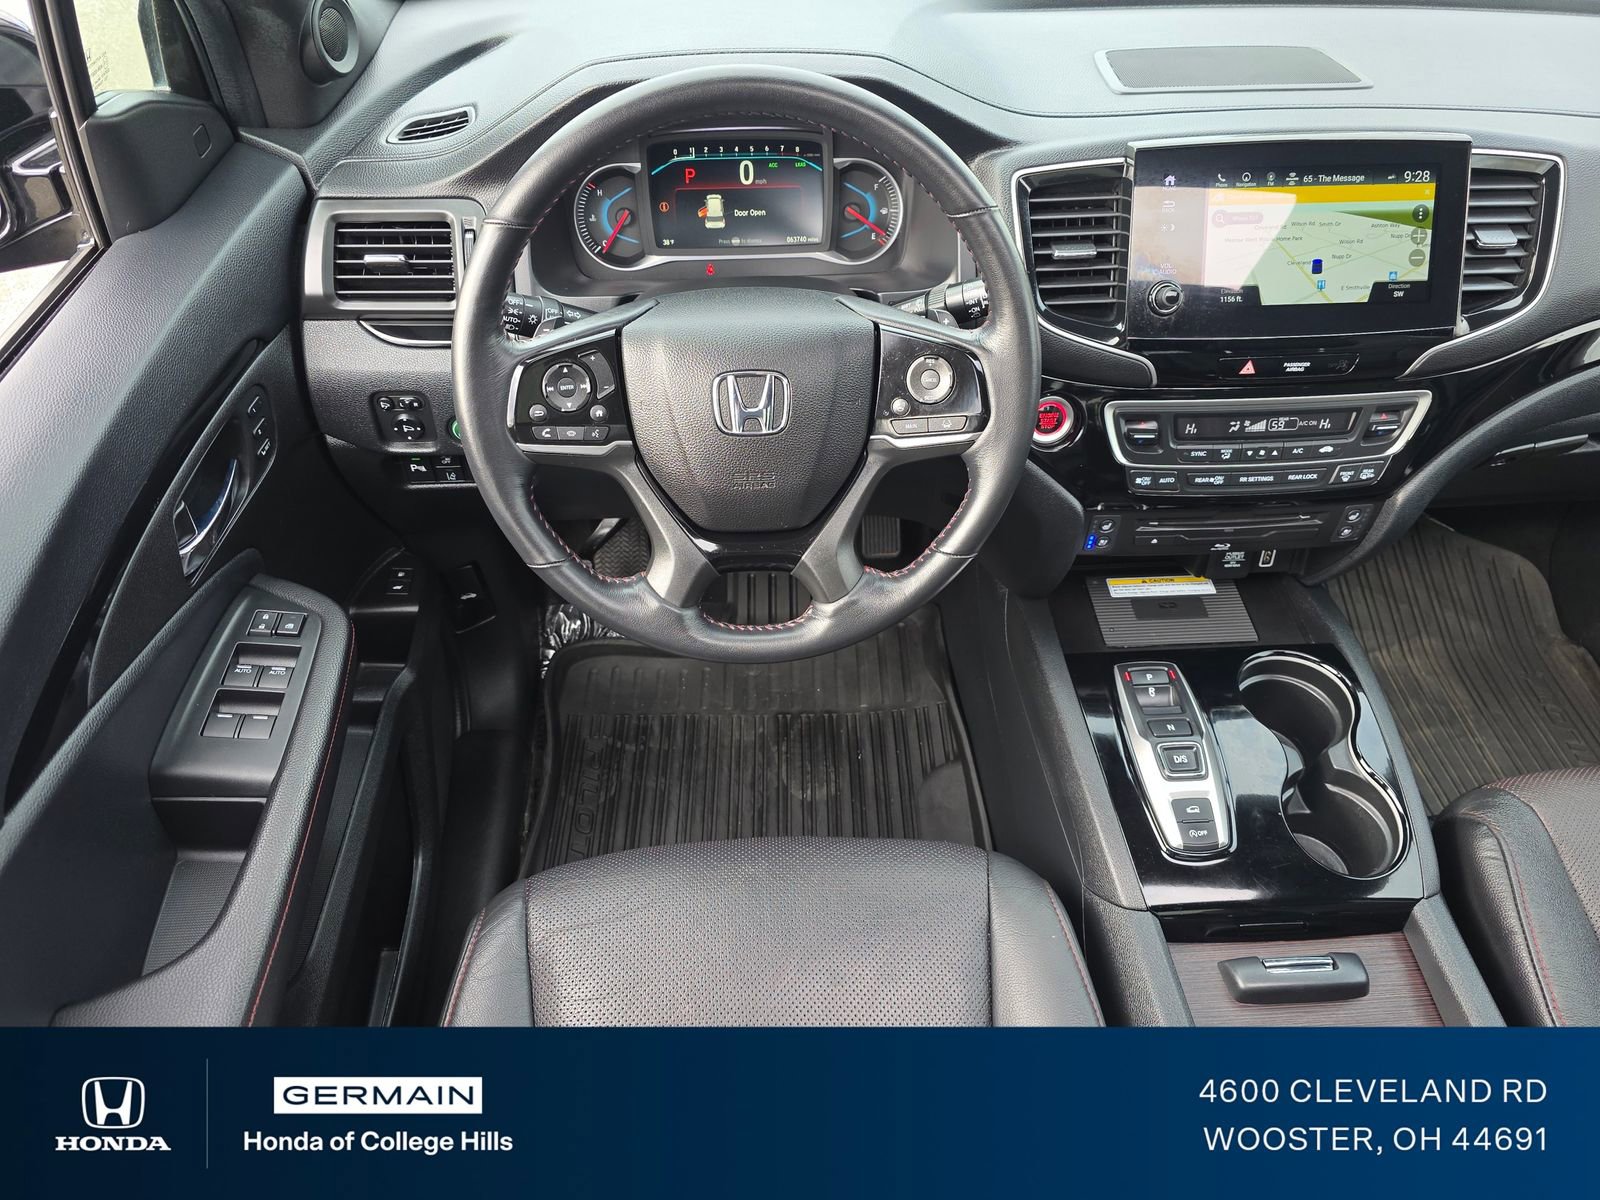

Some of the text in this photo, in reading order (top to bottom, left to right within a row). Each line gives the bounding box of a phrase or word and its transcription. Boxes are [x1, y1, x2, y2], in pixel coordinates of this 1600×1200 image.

[685, 168, 696, 184] P
[739, 160, 754, 185] 0
[1404, 170, 1431, 183] 9:28
[1303, 175, 1312, 183] 65
[1318, 174, 1330, 182] The
[1332, 174, 1365, 184] Message
[734, 209, 766, 218] Door Open
[1393, 290, 1404, 298] SW
[1220, 295, 1235, 303] 1156
[1146, 673, 1153, 681] P
[1166, 724, 1176, 732] N
[1173, 754, 1188, 764] D/S
